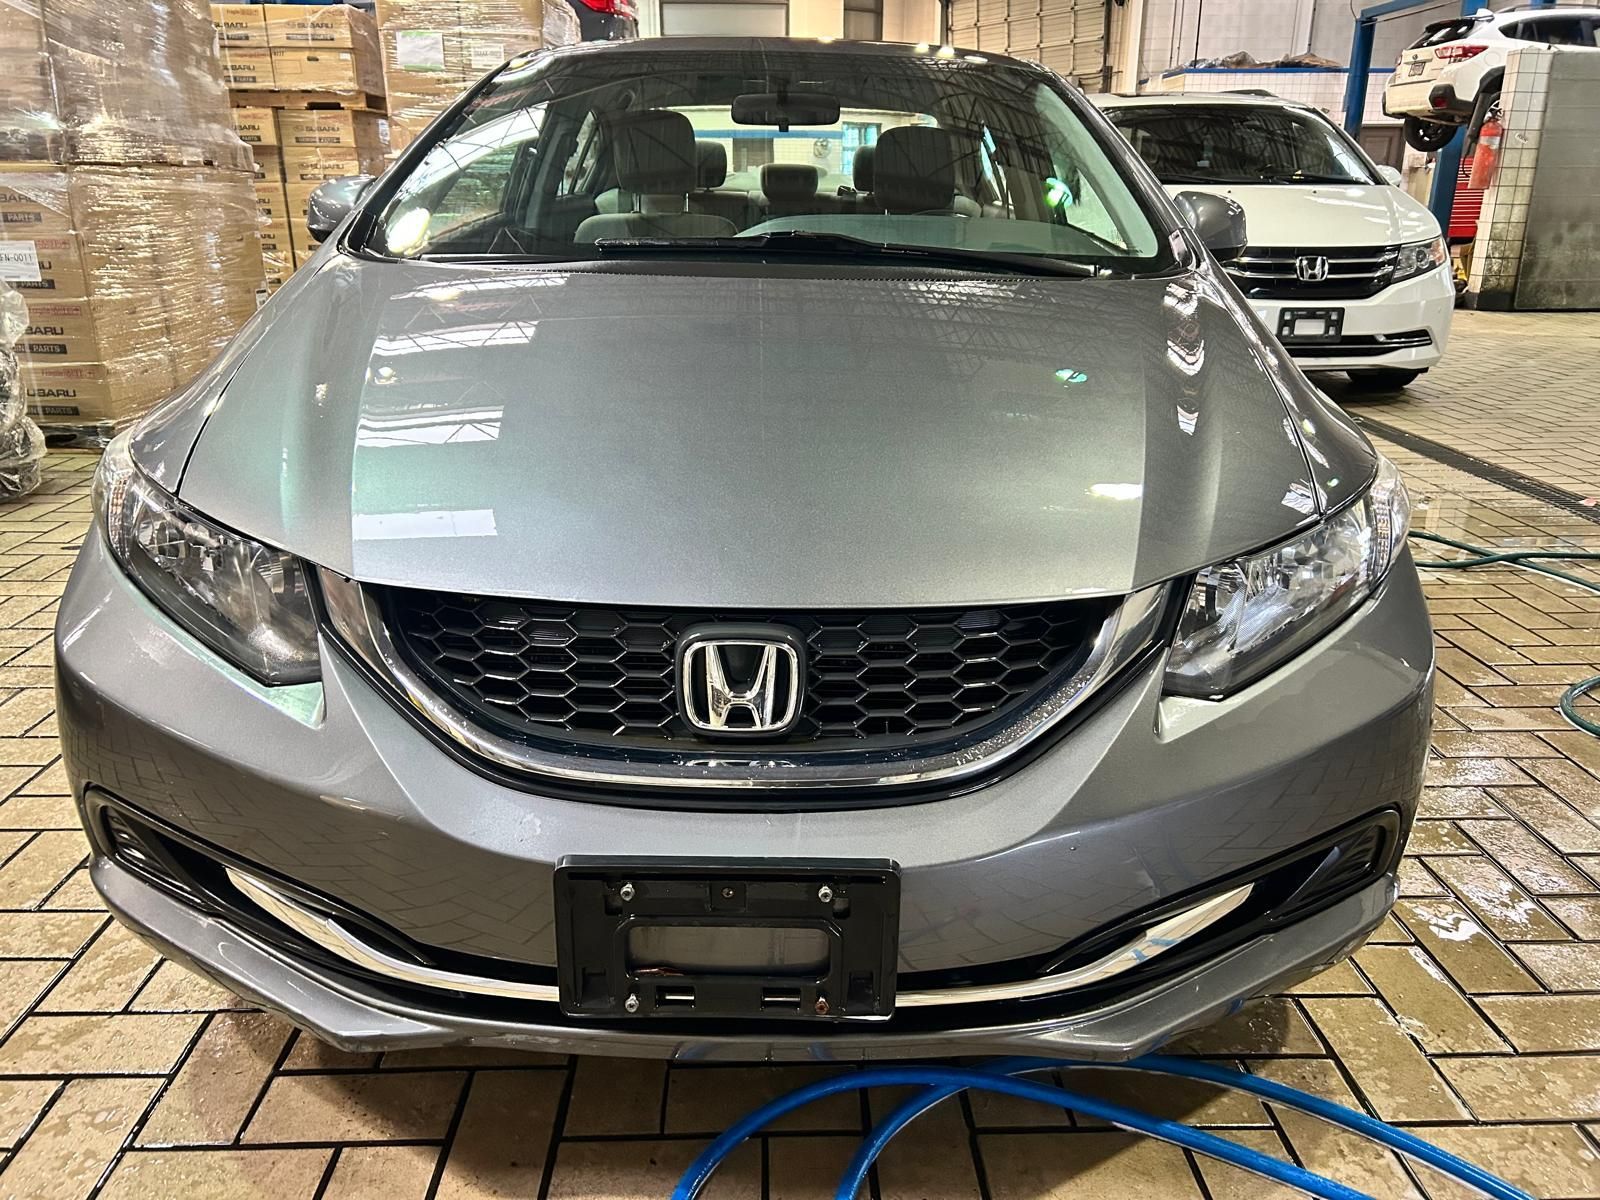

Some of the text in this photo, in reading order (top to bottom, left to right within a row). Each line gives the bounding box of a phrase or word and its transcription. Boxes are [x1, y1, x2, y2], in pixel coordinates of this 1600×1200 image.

[24, 326, 64, 336] BARU
[26, 389, 77, 398] UBARU
[45, 407, 73, 415] PARTS
